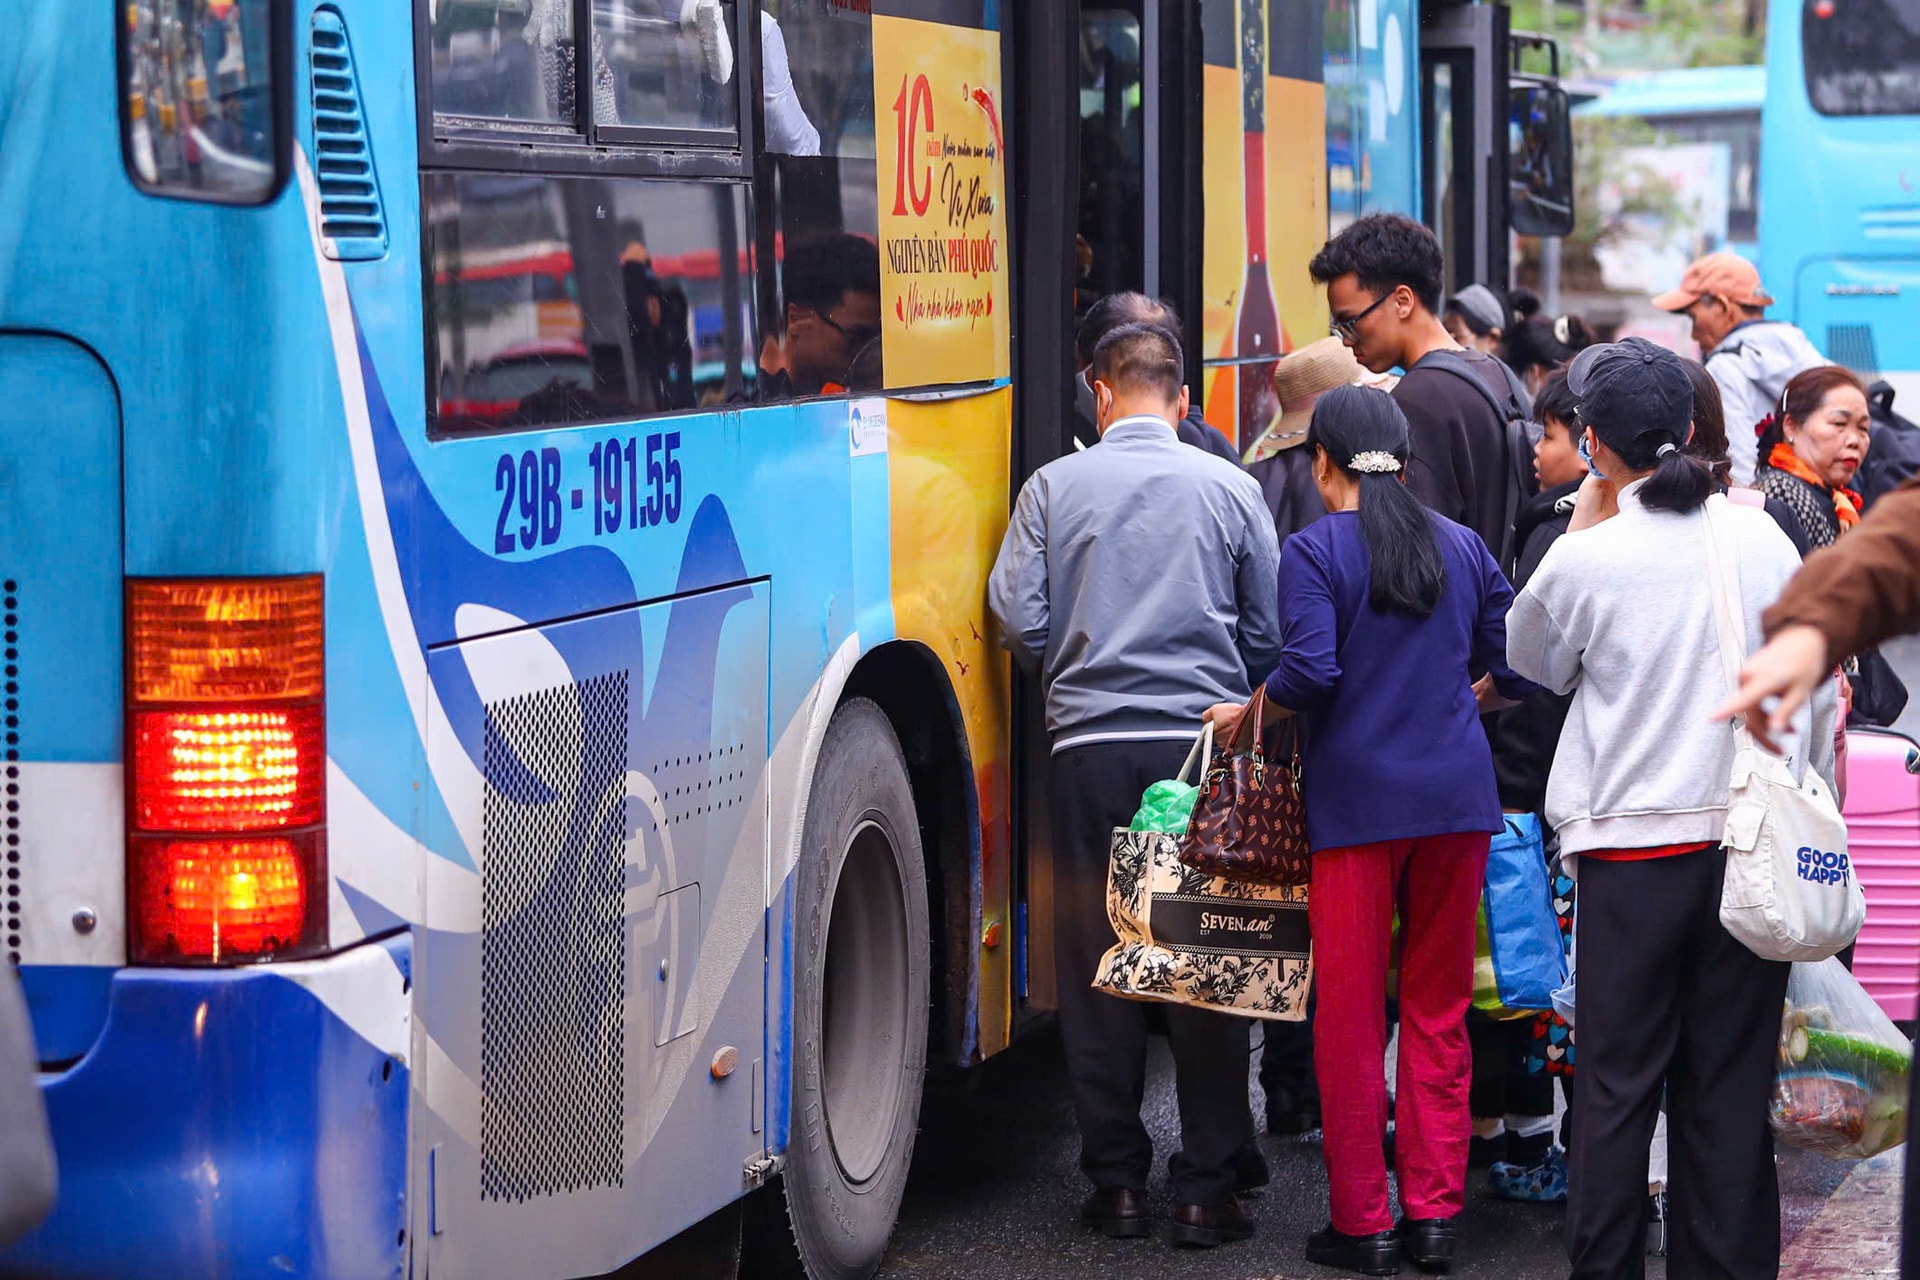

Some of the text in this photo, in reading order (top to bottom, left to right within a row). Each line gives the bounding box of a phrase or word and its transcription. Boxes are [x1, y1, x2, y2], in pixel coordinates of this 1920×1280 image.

[886, 229, 999, 280] NGUYÊN BẢN PHÚ QUỐC
[495, 447, 562, 555] 29B
[589, 431, 682, 536] 191.55
[1797, 846, 1849, 870] GOOD
